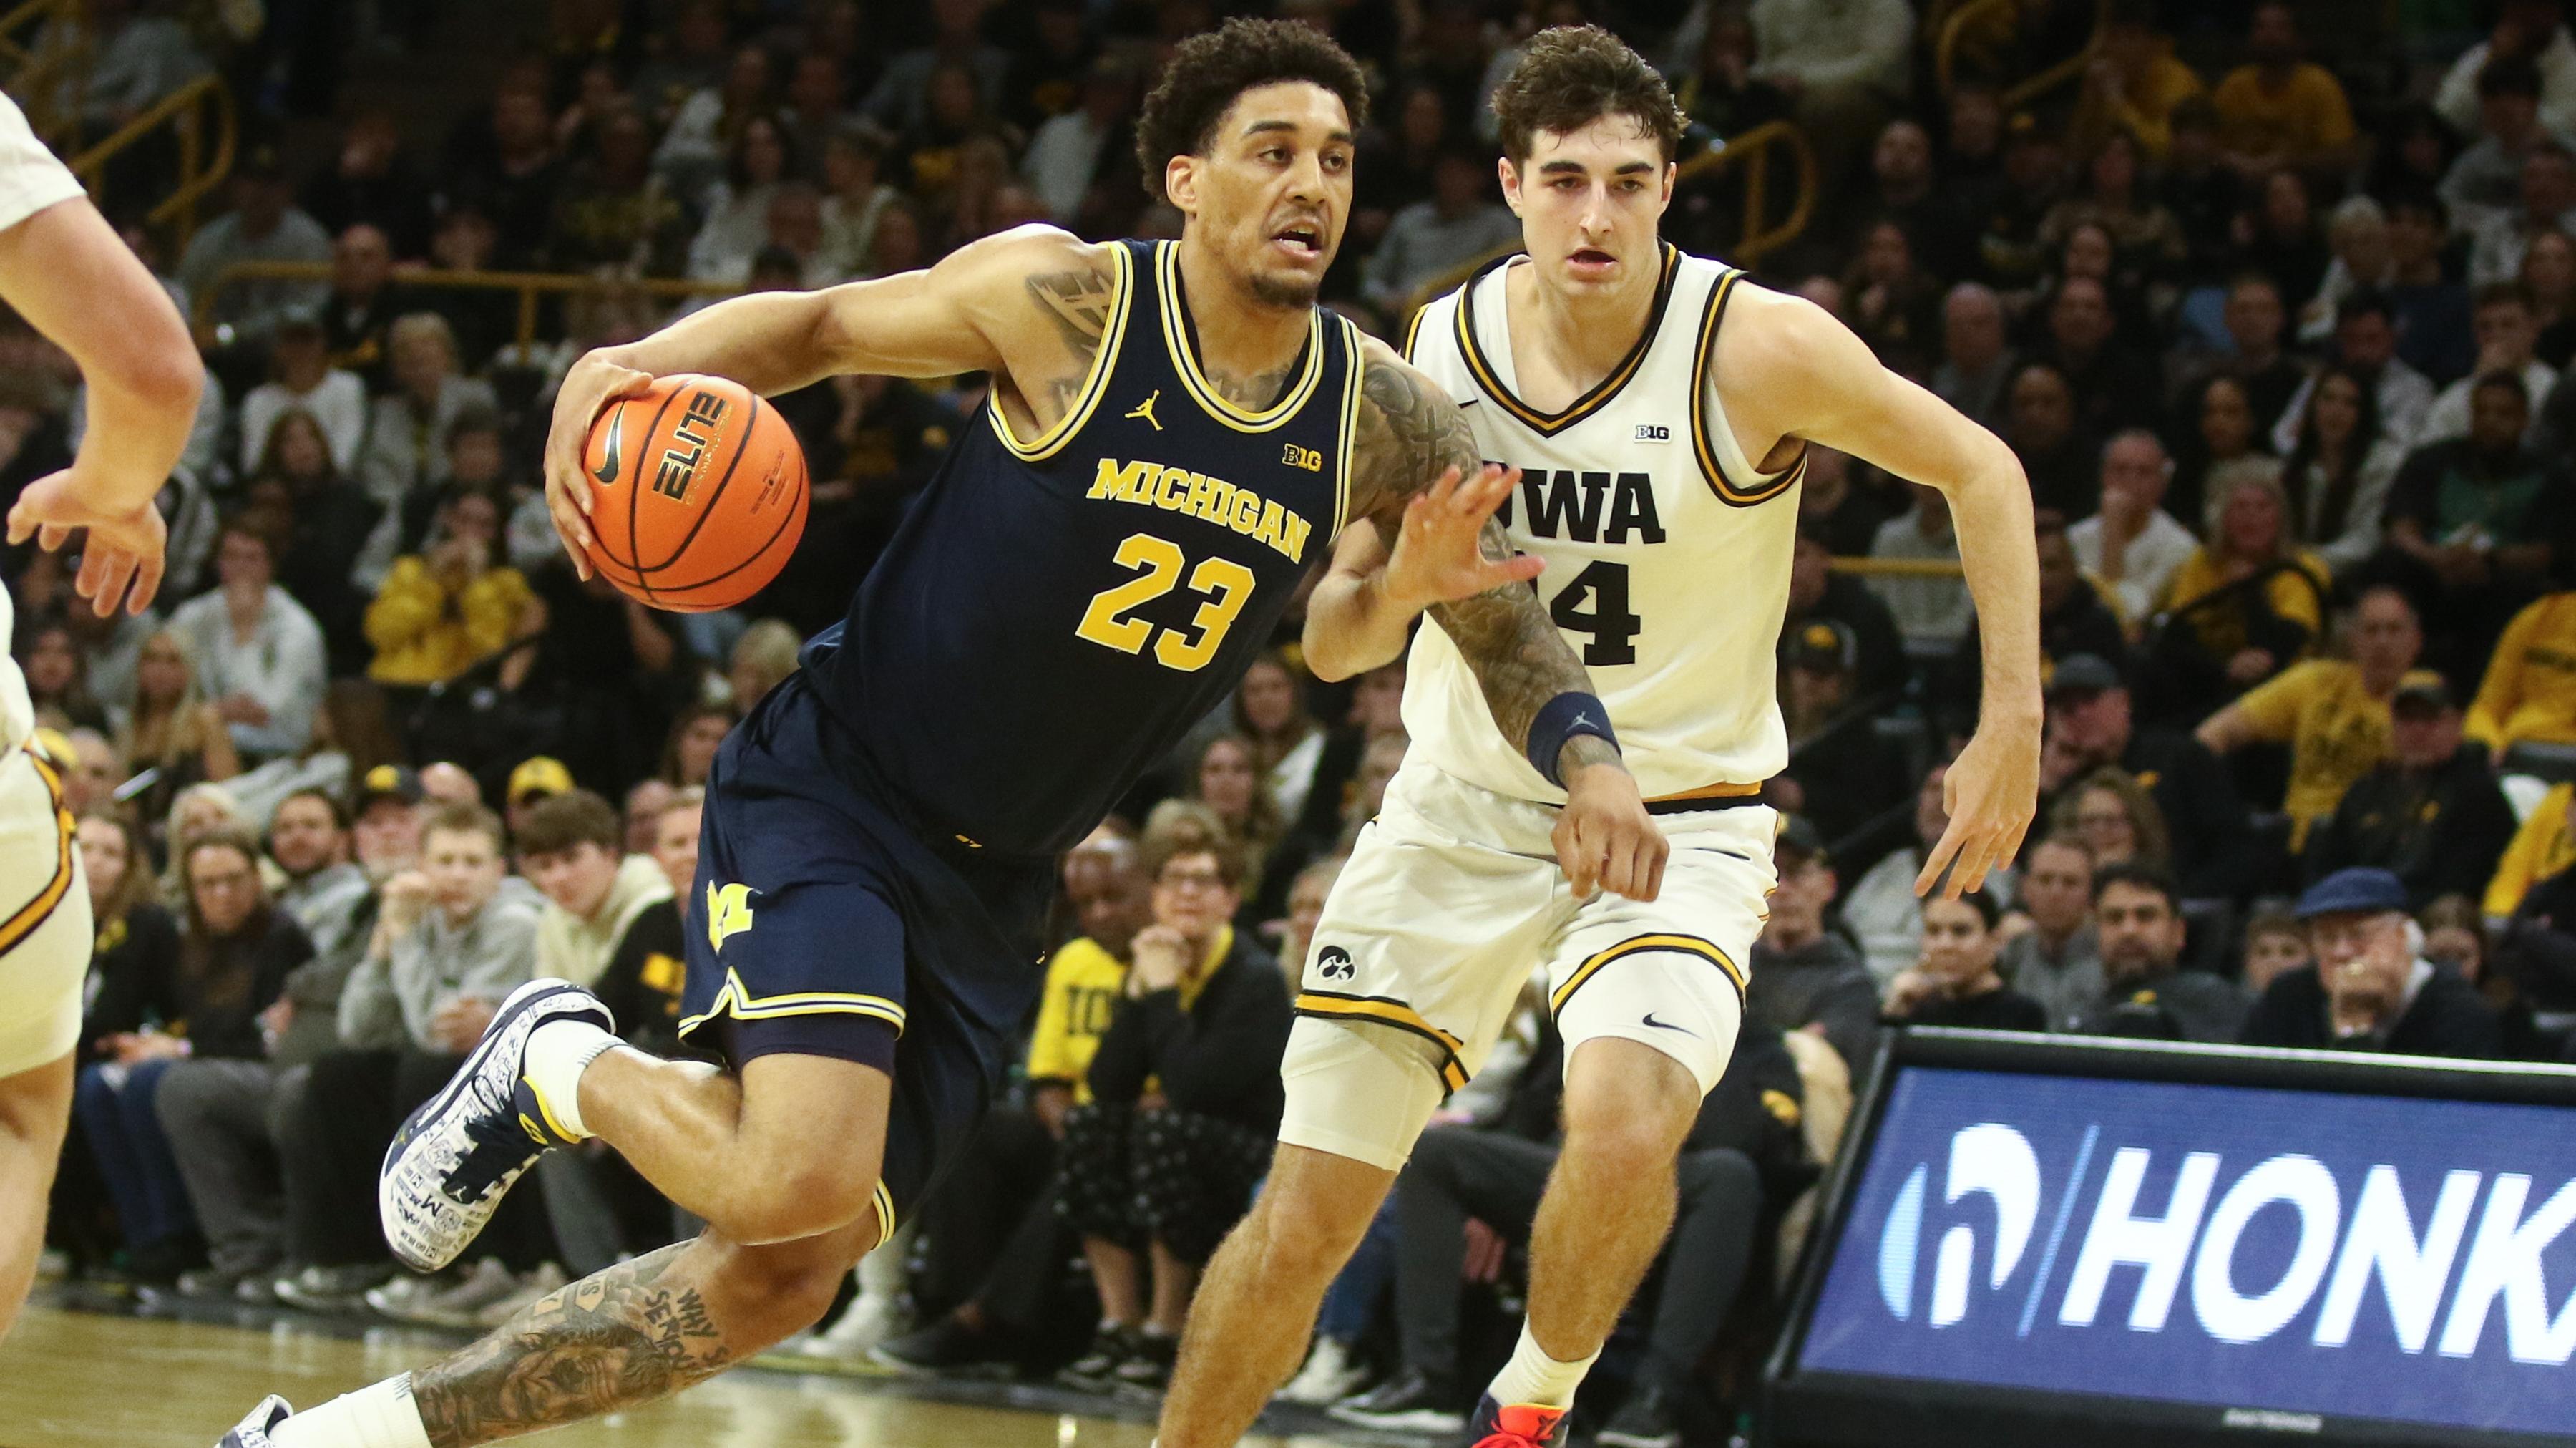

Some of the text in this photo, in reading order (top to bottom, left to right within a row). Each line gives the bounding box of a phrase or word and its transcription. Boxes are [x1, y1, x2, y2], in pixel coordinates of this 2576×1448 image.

[652, 391, 728, 502] ELITE
[1086, 458, 1312, 565] MICHIGAN
[1481, 460, 1666, 544] WA
[1075, 533, 1256, 672] 23
[421, 1195, 444, 1217] M
[2057, 1147, 2576, 1366] HONK
[676, 1288, 718, 1337] WHY
